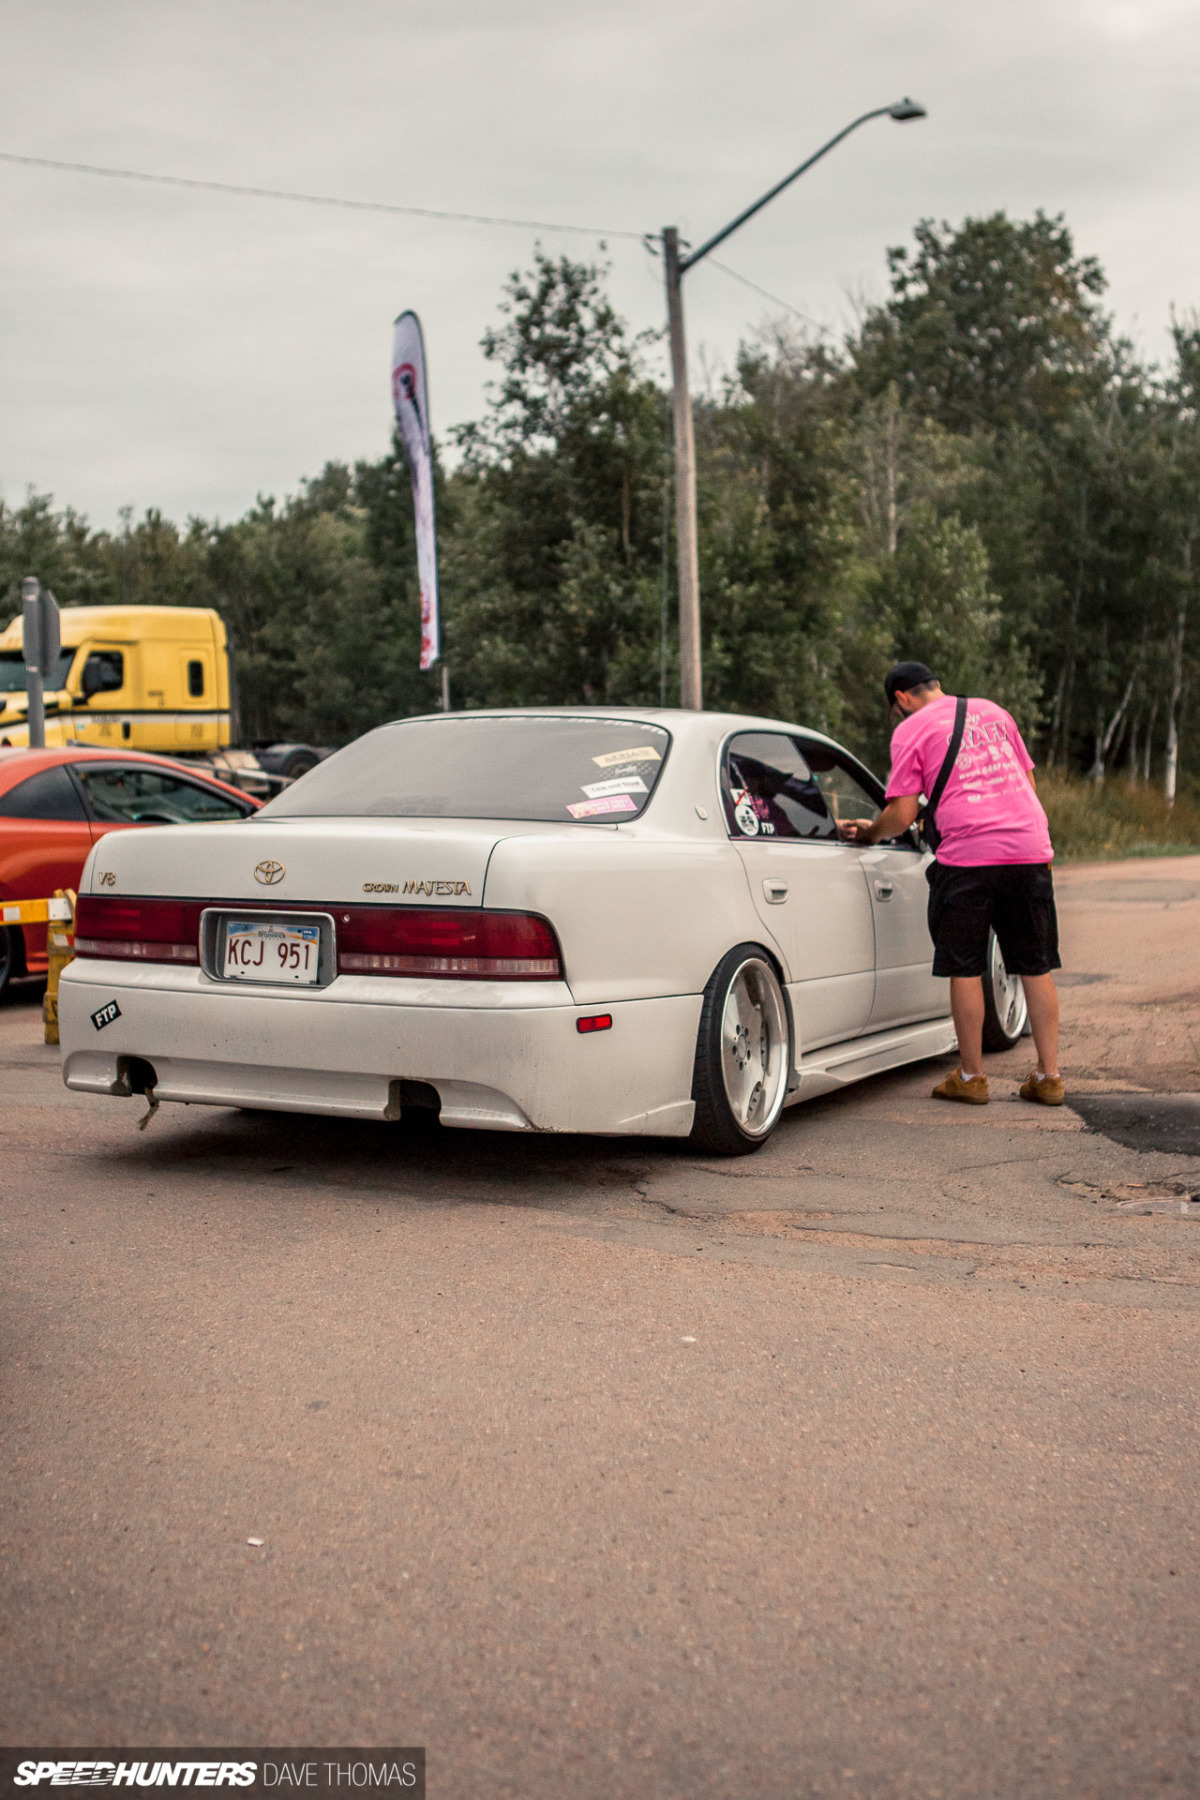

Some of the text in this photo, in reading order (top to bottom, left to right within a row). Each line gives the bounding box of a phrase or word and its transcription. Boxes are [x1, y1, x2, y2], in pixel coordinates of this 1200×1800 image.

[761, 822, 775, 834] FTP
[98, 871, 116, 886] V8
[363, 879, 472, 897] CROWN MAJESTA
[227, 938, 310, 970] KCJ 951
[94, 1004, 117, 1027] FTP
